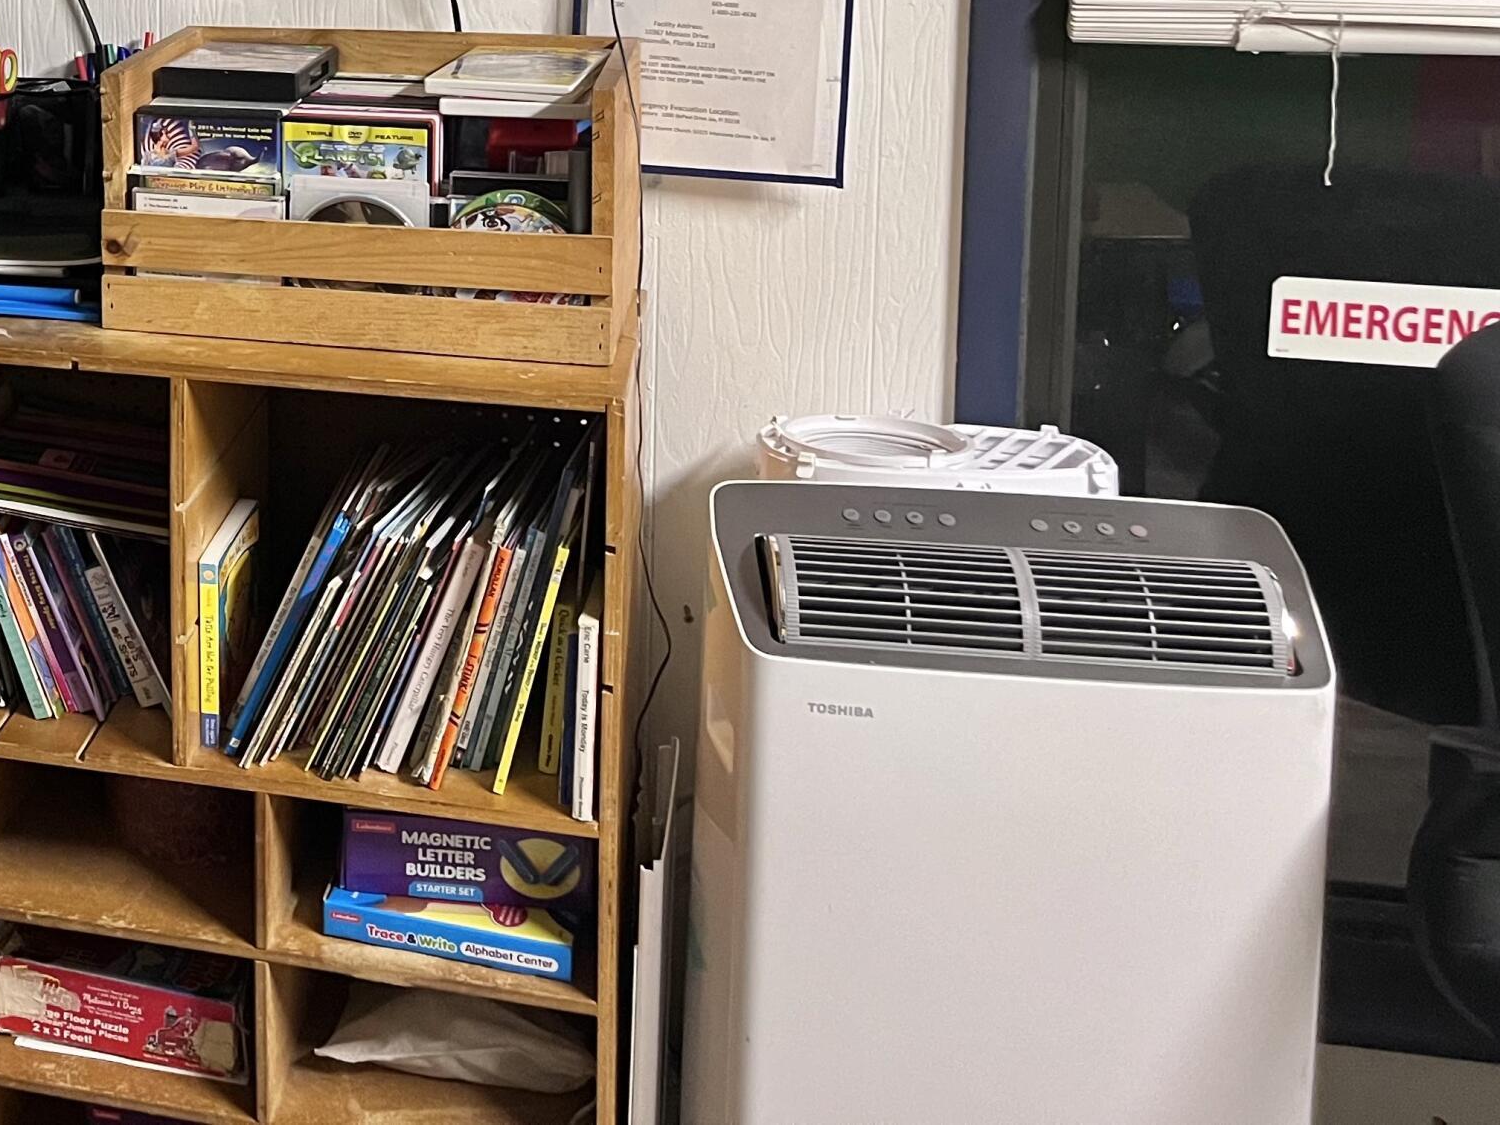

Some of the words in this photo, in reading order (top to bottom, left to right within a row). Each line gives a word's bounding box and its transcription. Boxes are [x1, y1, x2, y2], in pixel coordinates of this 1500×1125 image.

[444, 608, 455, 623] The
[559, 610, 570, 633] Quick
[437, 623, 450, 639] Very
[583, 626, 592, 642] Eric
[423, 642, 441, 669] Hungry
[582, 644, 592, 663] Carle
[460, 661, 475, 694] STINK!
[408, 672, 429, 712] Caterpillar
[580, 690, 589, 711] Today
[808, 702, 874, 719] TOSHIBA
[579, 723, 588, 753] Monday
[401, 830, 492, 850] MAGNETIC
[417, 847, 475, 865] LETTER
[405, 862, 487, 882] BUILDERS
[416, 883, 457, 895] STARTER
[458, 885, 475, 897] SET
[367, 925, 404, 942] Trace
[407, 932, 417, 944] &
[418, 934, 457, 953] Write
[465, 944, 515, 963] Alphabet
[516, 953, 555, 970] Center
[45, 1010, 61, 1020] rge
[63, 1011, 92, 1026] Floor
[94, 1018, 130, 1035] Puzzle
[66, 1021, 97, 1036] Jumbo
[99, 1029, 129, 1043] Pieces
[33, 1023, 40, 1033] 2
[43, 1026, 50, 1034] x
[53, 1026, 60, 1036] 3
[63, 1030, 92, 1045] Feet!
